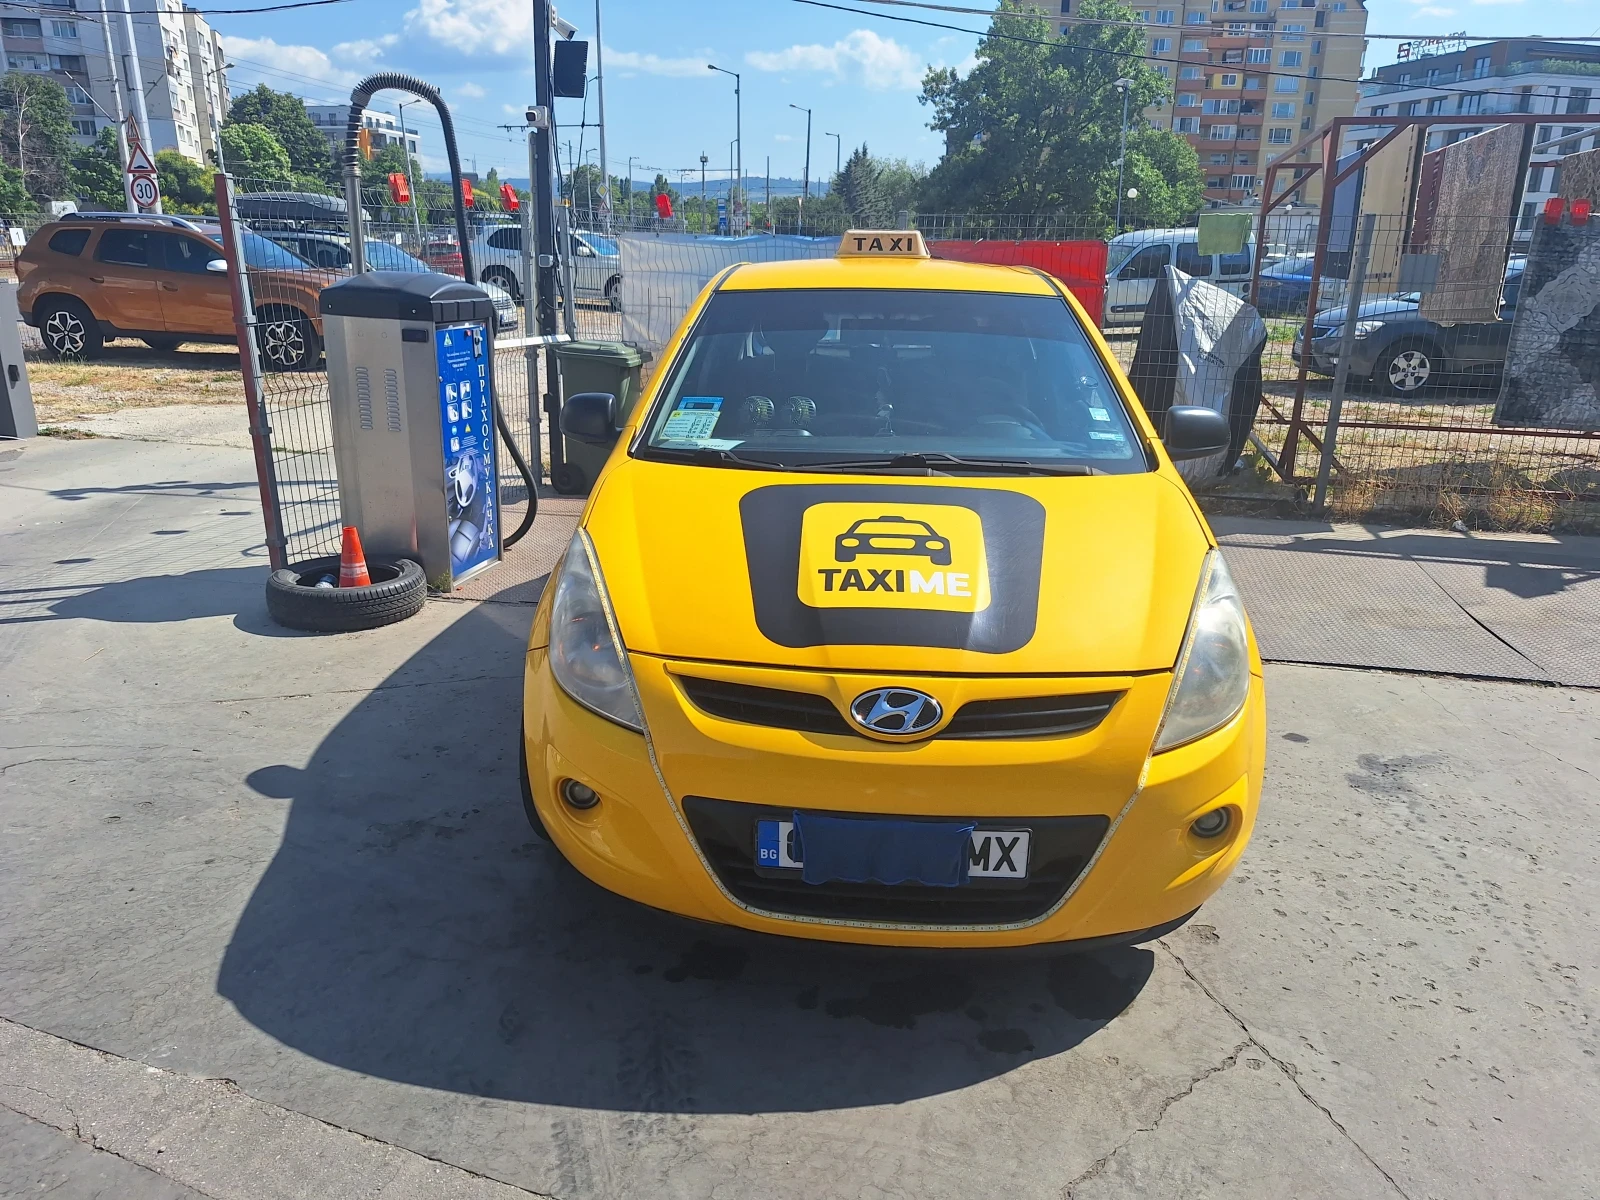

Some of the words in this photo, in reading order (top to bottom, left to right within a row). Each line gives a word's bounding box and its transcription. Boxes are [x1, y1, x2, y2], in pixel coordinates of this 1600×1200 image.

[136, 183, 153, 199] 30
[853, 237, 913, 252] TAXI
[477, 363, 495, 550] ПРАХОСМУКАЧКА
[760, 848, 778, 860] BG
